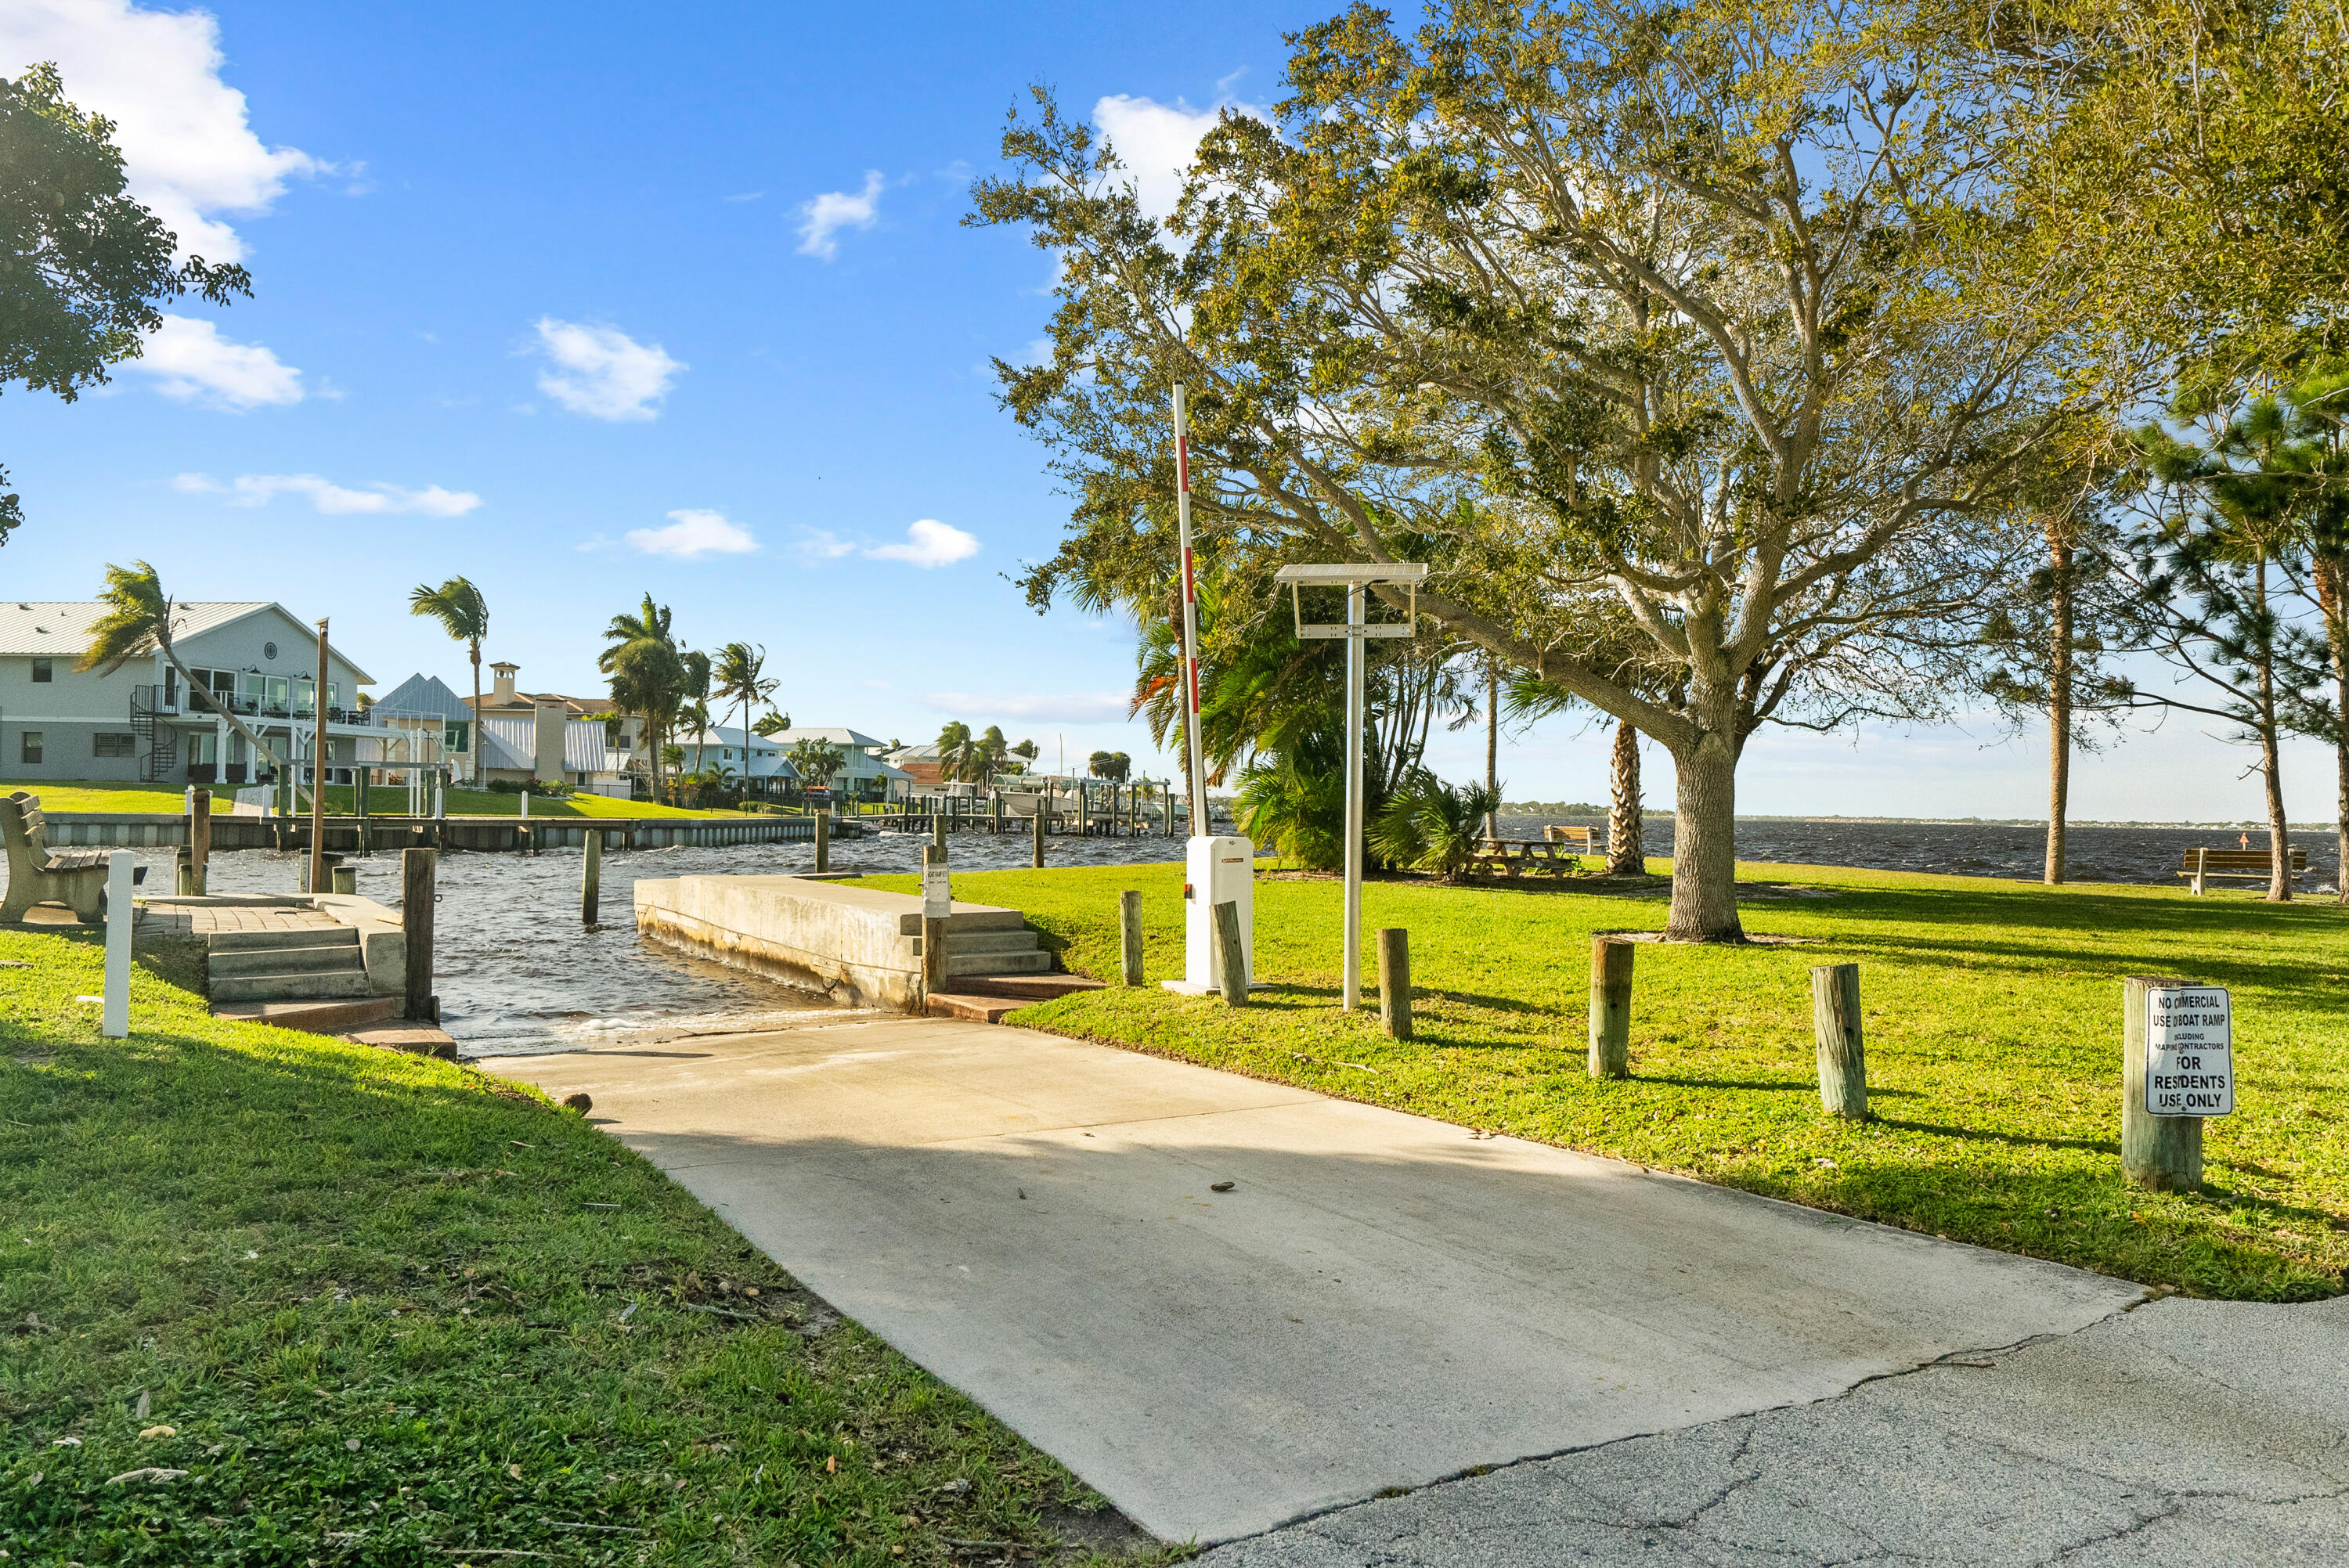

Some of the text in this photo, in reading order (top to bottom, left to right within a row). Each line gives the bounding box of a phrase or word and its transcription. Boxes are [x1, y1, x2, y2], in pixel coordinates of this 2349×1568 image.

[2159, 997, 2171, 1009] NO
[2153, 1015, 2171, 1028] USE
[2178, 1015, 2199, 1026] BOAT
[2203, 1014, 2225, 1026] RAMP
[2176, 1056, 2201, 1070] FOR
[2154, 1075, 2225, 1089] RESIDENTS
[2159, 1093, 2222, 1107] USE ONLY
